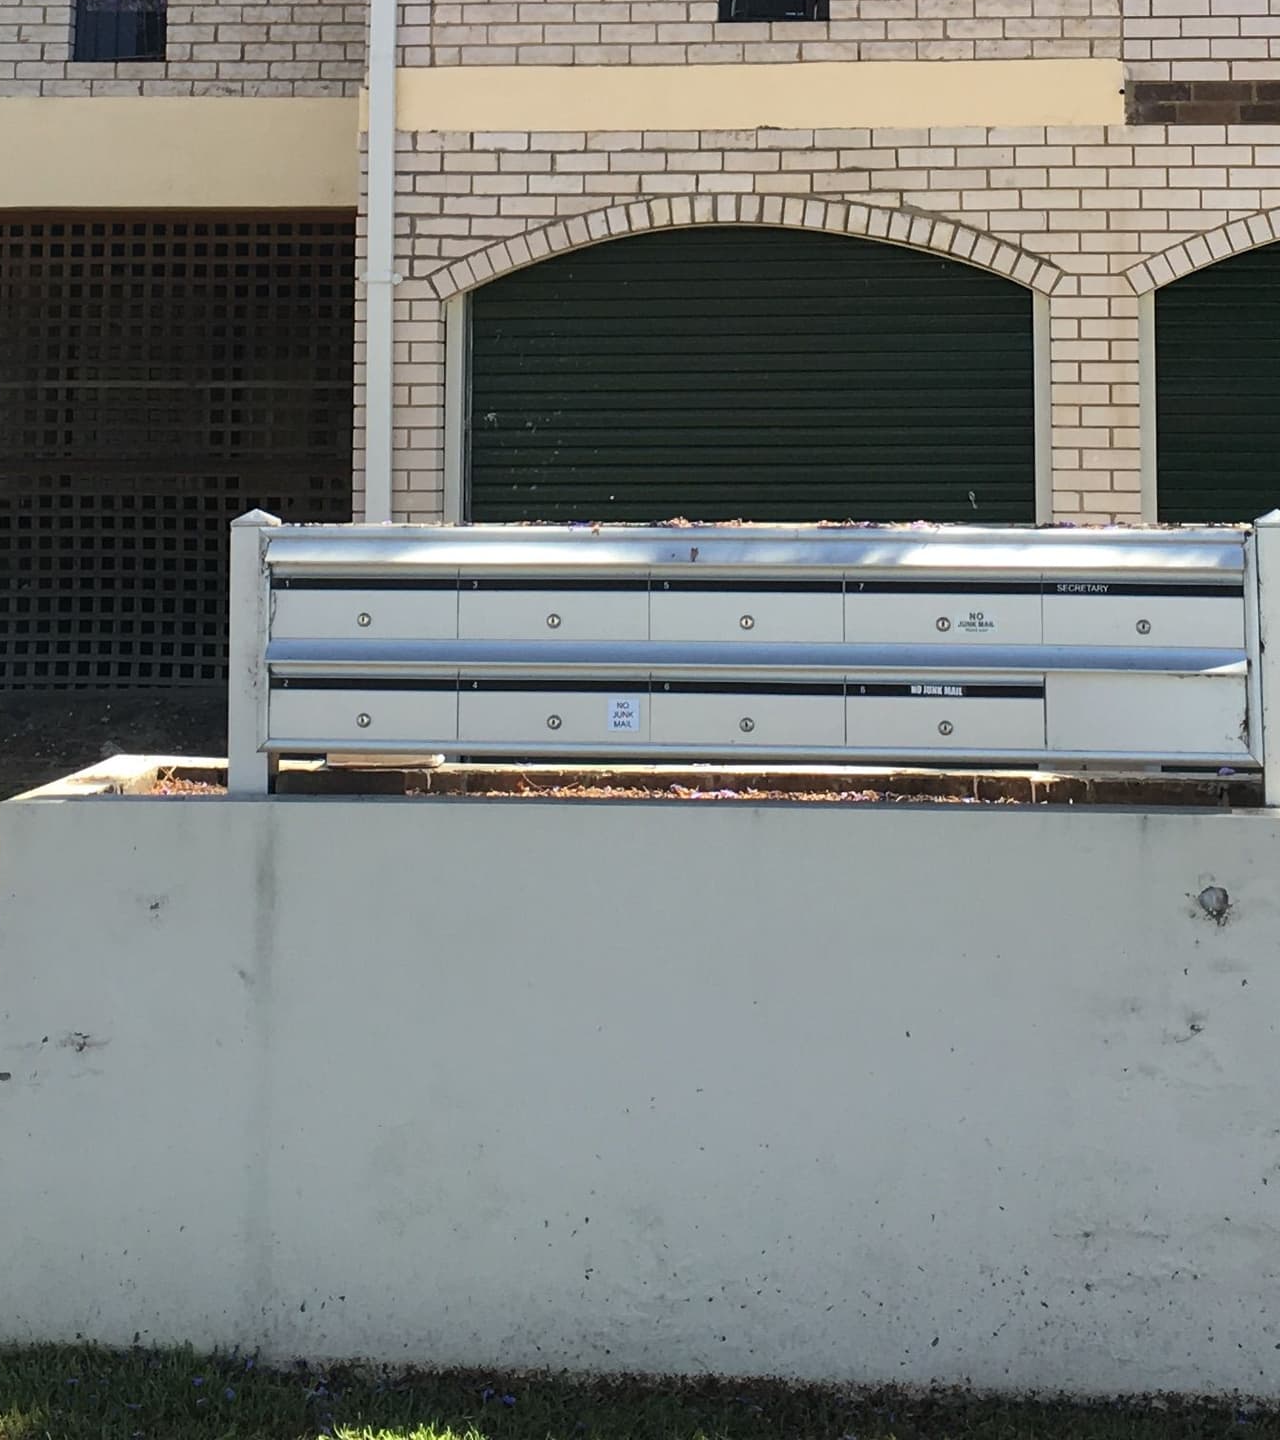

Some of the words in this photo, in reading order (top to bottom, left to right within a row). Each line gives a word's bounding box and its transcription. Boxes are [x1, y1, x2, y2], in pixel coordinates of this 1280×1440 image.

[1056, 583, 1109, 593] SECRETARY
[969, 612, 984, 621] NO
[616, 701, 630, 709] NO
[612, 711, 634, 719] JUNK
[613, 720, 632, 729] MAIL
